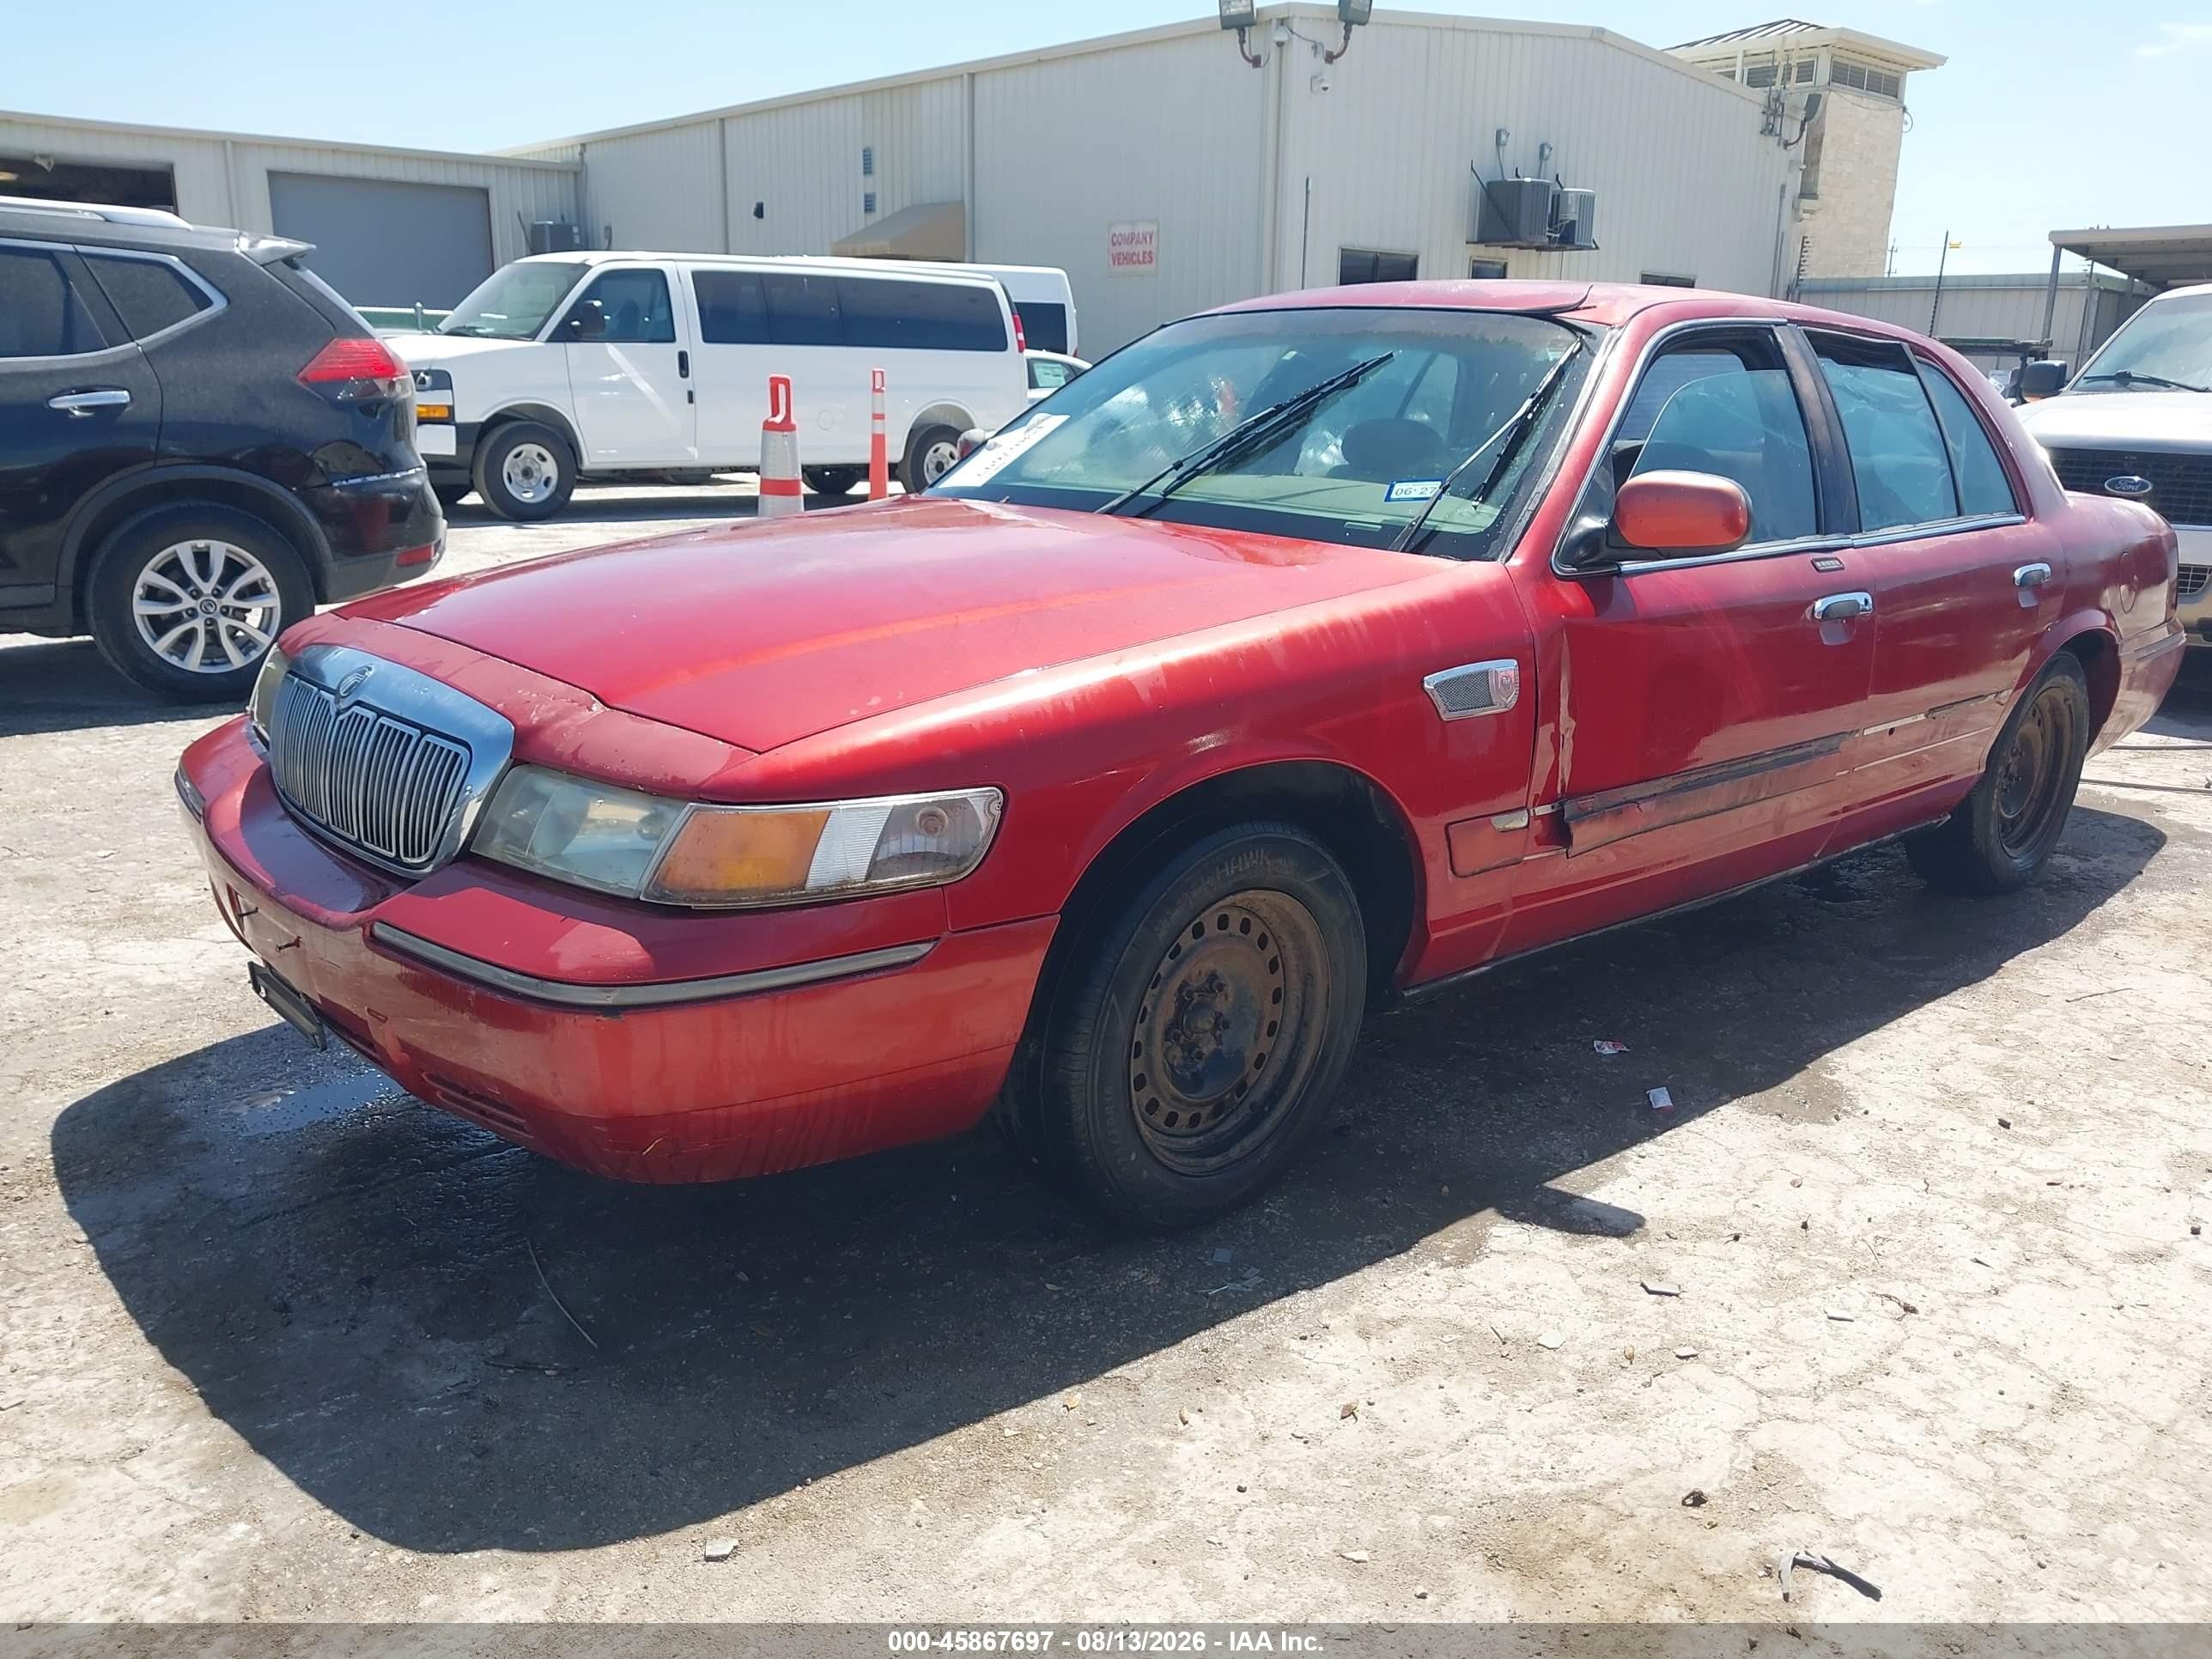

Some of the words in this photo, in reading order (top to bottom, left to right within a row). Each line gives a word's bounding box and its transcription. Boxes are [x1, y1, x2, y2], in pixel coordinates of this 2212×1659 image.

[1111, 230, 1154, 246] COMPANY
[1111, 250, 1154, 266] VEHICLES
[2115, 479, 2142, 491] Ford
